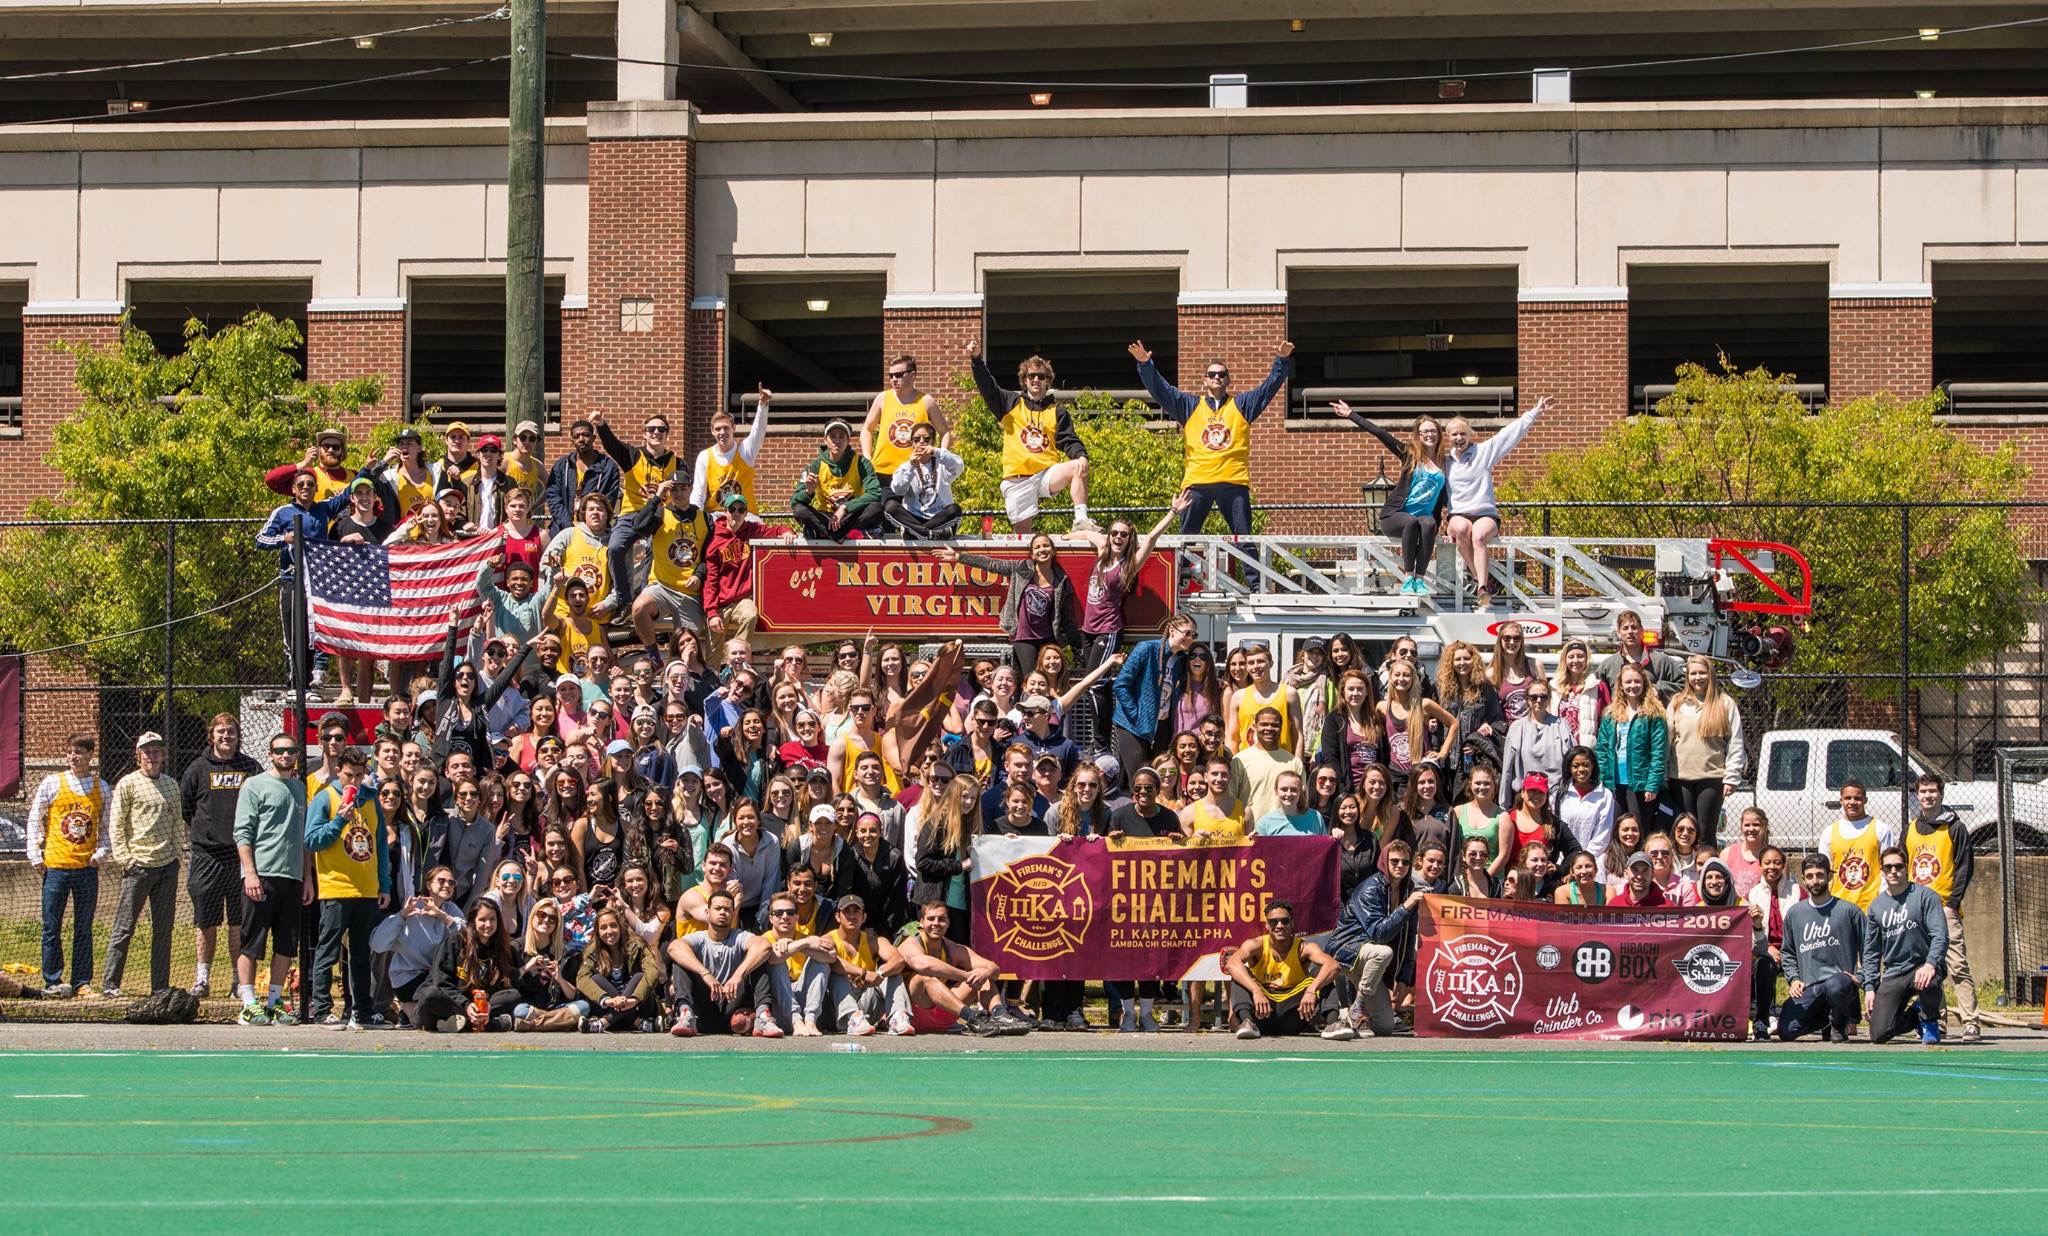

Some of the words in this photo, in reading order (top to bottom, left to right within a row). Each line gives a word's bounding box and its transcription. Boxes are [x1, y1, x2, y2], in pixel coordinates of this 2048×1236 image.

[789, 566, 824, 589] City
[837, 562, 1010, 586] RICHMO
[801, 580, 817, 599] of
[866, 595, 1001, 616] VIRGINI
[212, 774, 242, 787] VCU
[1016, 864, 1063, 878] FIREMAN'S
[1111, 858, 1266, 890] FIREMAN'S
[1111, 892, 1274, 923] CHALLENGE
[1554, 911, 1679, 928] CHALLENGE
[1683, 915, 1731, 930] 2016
[1803, 918, 1831, 942] Urb
[1111, 929, 1124, 939] PI
[1132, 929, 1178, 939] KAPPA
[1184, 928, 1233, 939] ALPHA
[1014, 936, 1064, 951] CHALLENGE
[1110, 940, 1144, 948] LAMBDA
[1145, 940, 1159, 948] CHI
[1161, 940, 1198, 948] CHAPTER
[1454, 942, 1497, 956] FIREMAN'S
[1620, 942, 1660, 954] HIBACHI
[1619, 955, 1659, 979] BOX
[1692, 955, 1720, 966] Steak
[1690, 969, 1721, 981] Shake
[1545, 991, 1579, 1018] Urb
[1451, 1008, 1497, 1022] CHALLENGE
[1533, 1015, 1583, 1034] Grinder
[1585, 1010, 1604, 1025] Co.
